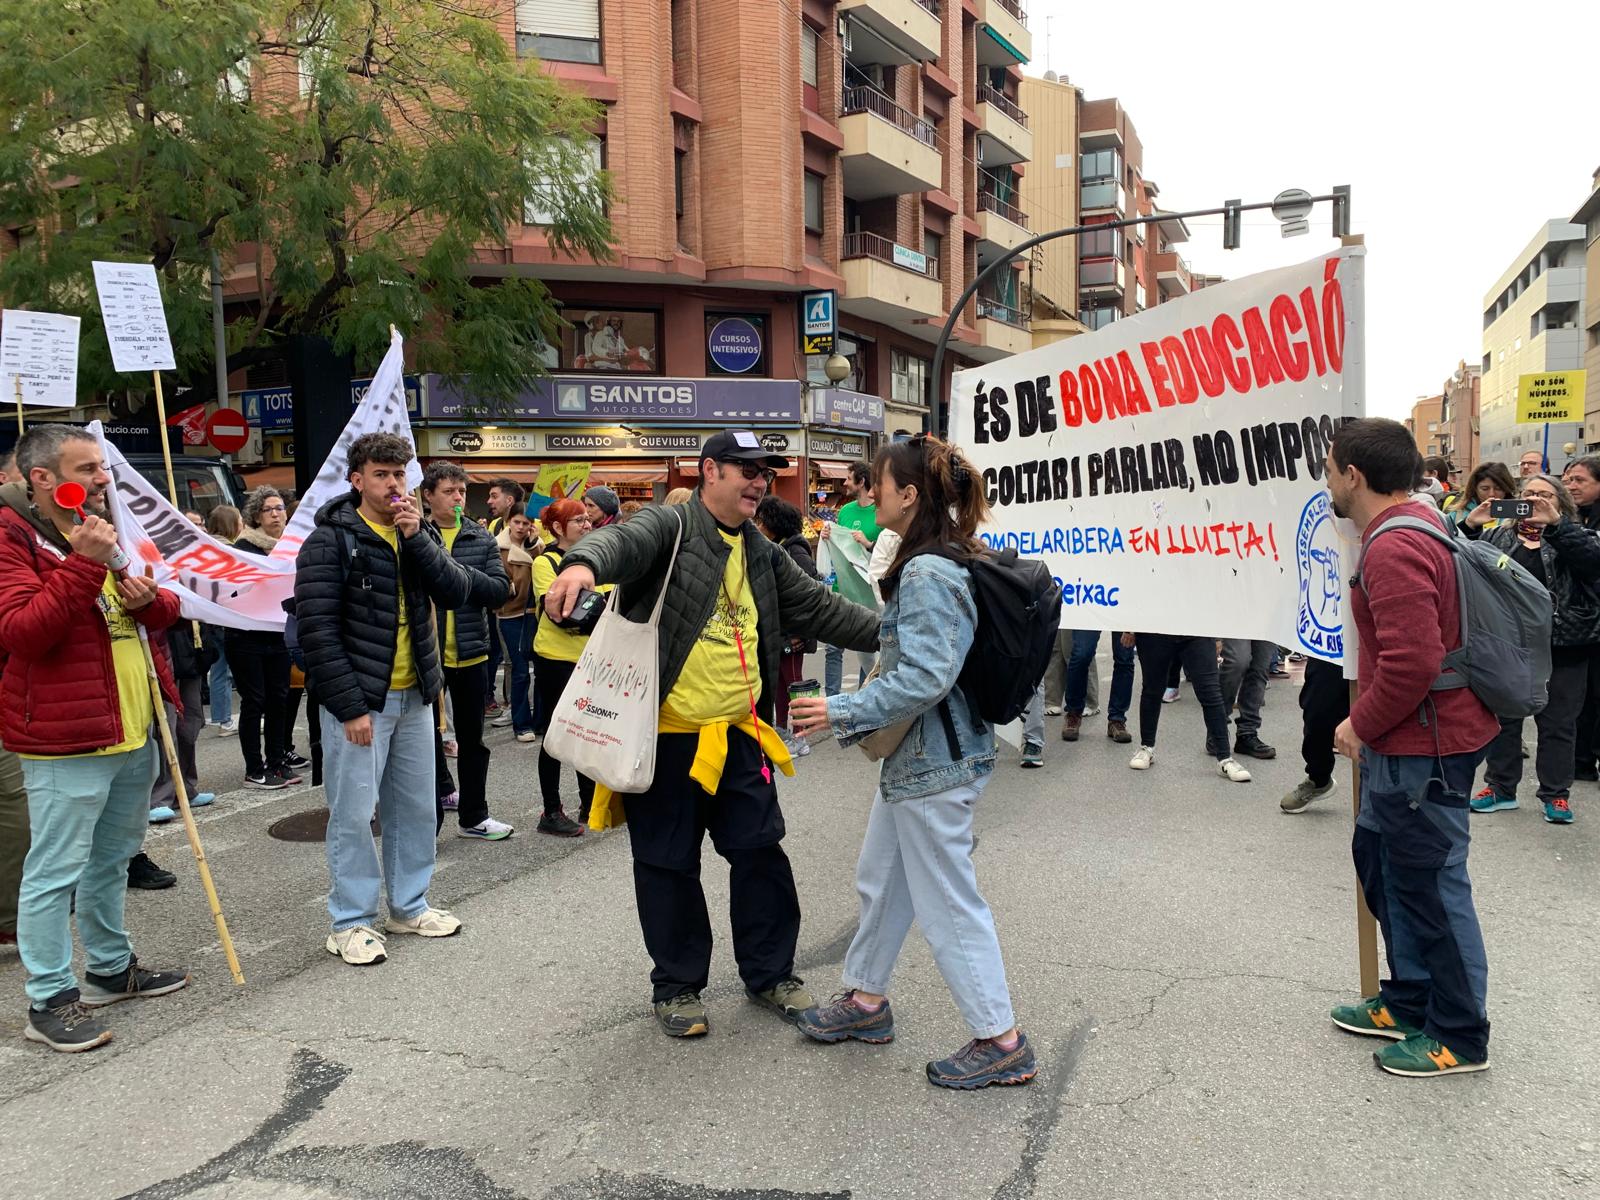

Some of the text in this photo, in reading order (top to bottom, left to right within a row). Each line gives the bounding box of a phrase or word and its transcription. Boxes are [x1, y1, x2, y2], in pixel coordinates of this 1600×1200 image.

[720, 335, 751, 343] CURSOS
[712, 345, 758, 354] INTENSIVOS
[974, 257, 1345, 444] ÉS DE BONA EDUCACIÓ
[1534, 375, 1565, 387] NO SÓN
[590, 385, 693, 404] SANTOS
[264, 393, 293, 411] TOTS
[833, 399, 852, 412] centre
[852, 398, 865, 414] CAP
[1540, 398, 1556, 408] SÓN
[592, 406, 692, 414] AUTOESCOLES
[1527, 410, 1569, 420] PERSONES
[104, 425, 149, 435] bucio.com
[451, 437, 481, 447] Fresh
[552, 437, 697, 447] COLMADO QUEVIURES
[761, 439, 787, 447] Fresh
[811, 440, 834, 451] COLMADO
[981, 413, 1357, 508] COLTAR I PARLAR, NO IMPOS
[976, 521, 1279, 561] OMDELARIBERA EN LLUITA!
[1310, 629, 1323, 647] LA
[1326, 633, 1343, 652] RIB
